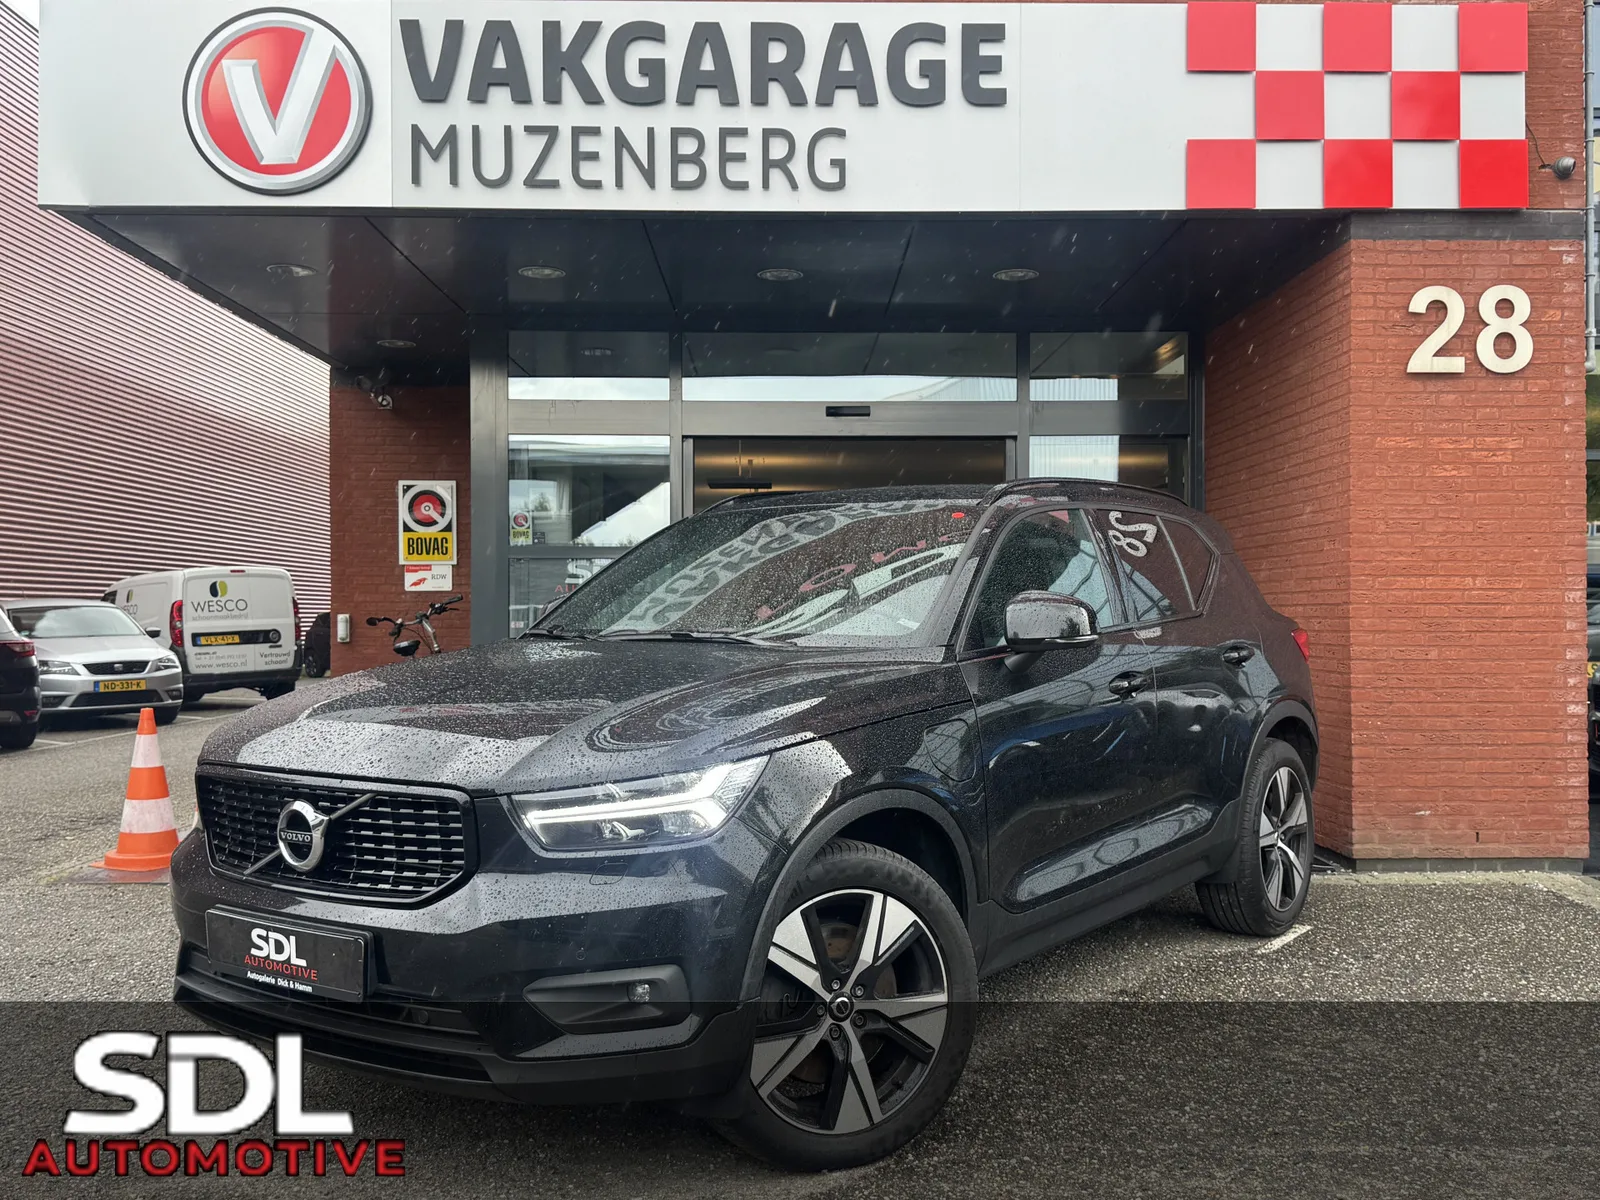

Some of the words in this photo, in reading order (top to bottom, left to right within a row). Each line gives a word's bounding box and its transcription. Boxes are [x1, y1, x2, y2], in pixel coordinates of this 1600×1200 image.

[400, 19, 1006, 107] VAKGARAGE
[411, 124, 847, 191] MUZENBERG
[1406, 284, 1535, 375] 28
[407, 537, 448, 556] BOVAG
[191, 599, 248, 613] WESCO
[204, 635, 236, 643] VLX-41-X
[259, 650, 291, 658] Vertrouwd
[264, 658, 288, 666] schoon!
[195, 660, 248, 669] www.wesco.nl
[103, 681, 142, 690] ND-331-K
[280, 832, 312, 843] VOLVO
[250, 928, 307, 966] SDL
[244, 954, 319, 981] AUTOMOTIVE
[246, 970, 276, 985] Autogalerie
[277, 978, 289, 988] Dick
[289, 980, 294, 989] &
[294, 982, 313, 993] Hamm
